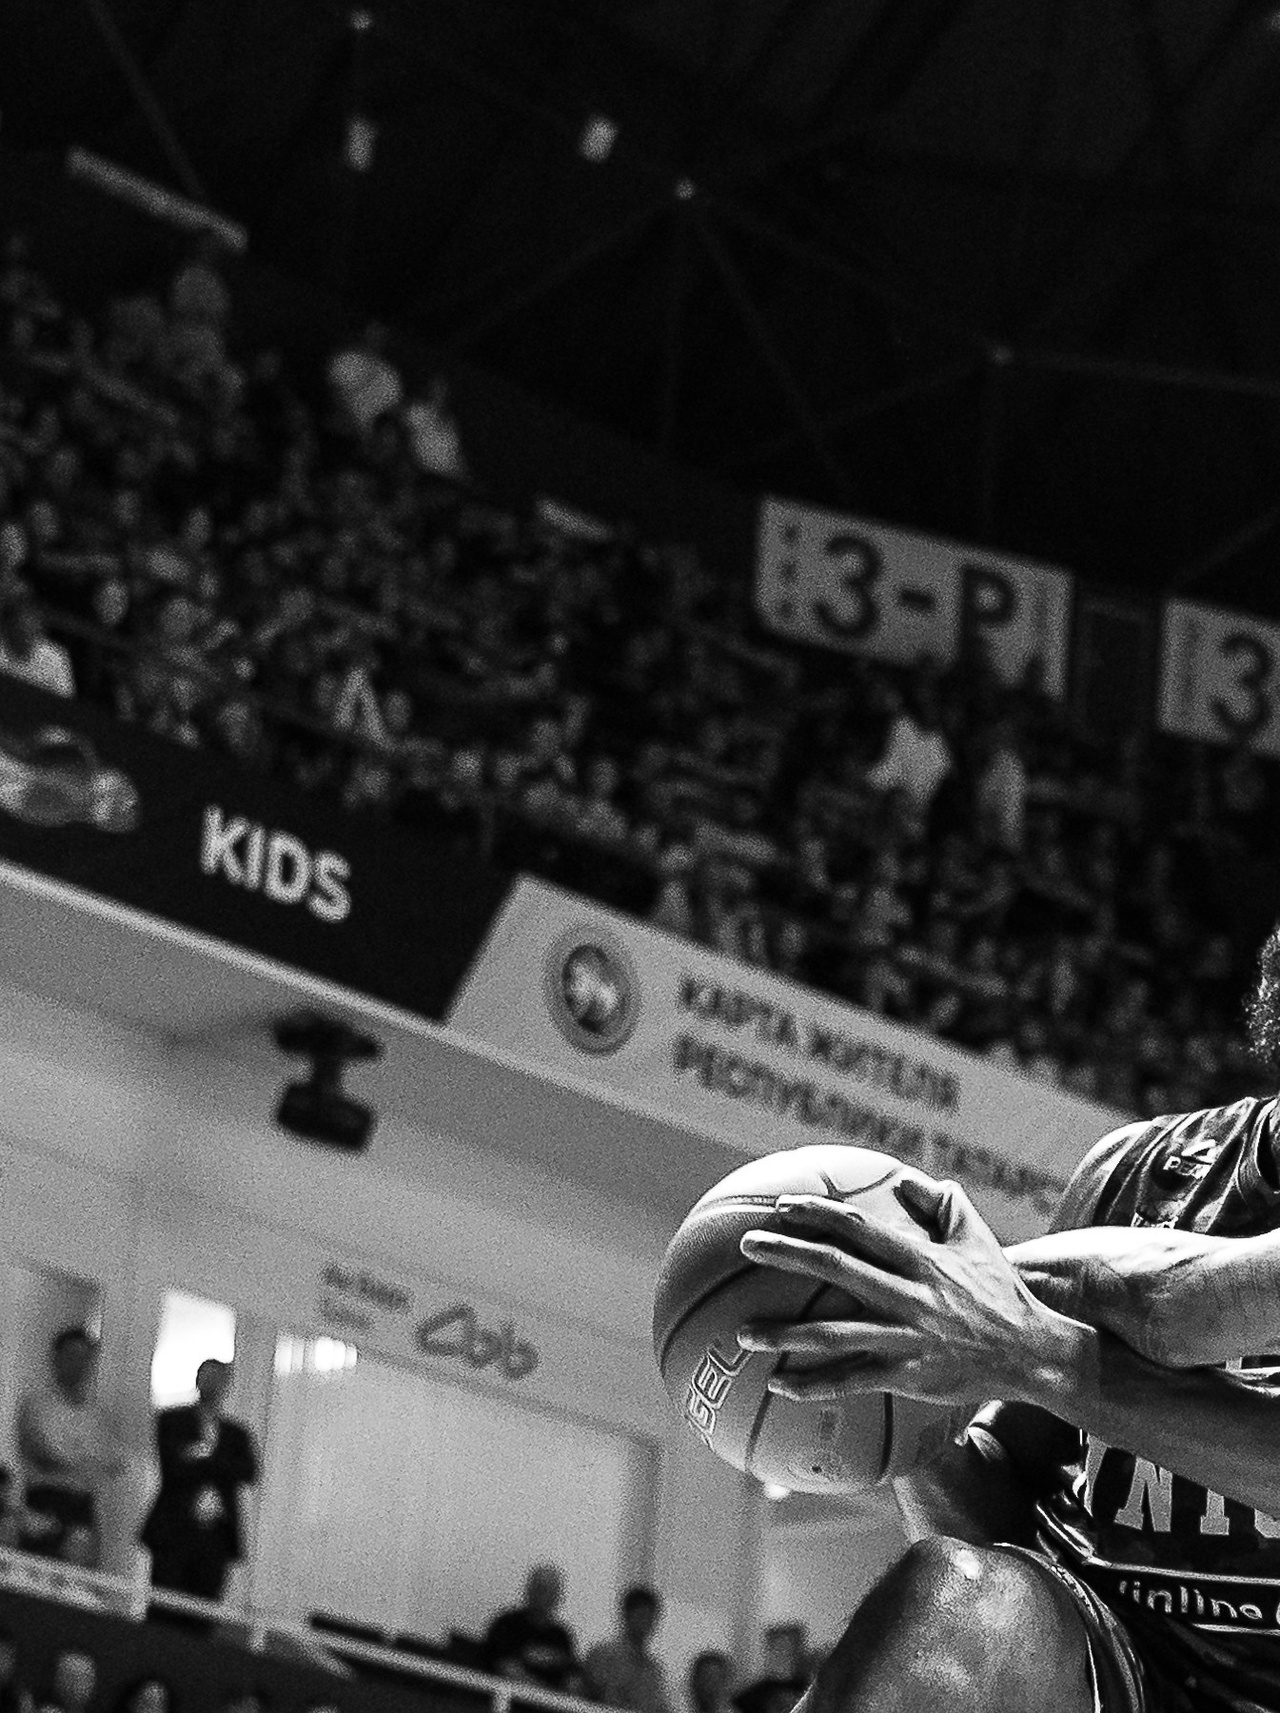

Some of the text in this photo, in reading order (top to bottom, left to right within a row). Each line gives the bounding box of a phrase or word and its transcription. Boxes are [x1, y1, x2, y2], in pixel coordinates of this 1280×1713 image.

[202, 807, 351, 921] KIDS
[674, 1035, 924, 1158] РЕСПУБЛИКИ
[679, 975, 960, 1113] КАРТА ЖИТЕЛЯ
[1118, 1579, 1263, 1620] inline
